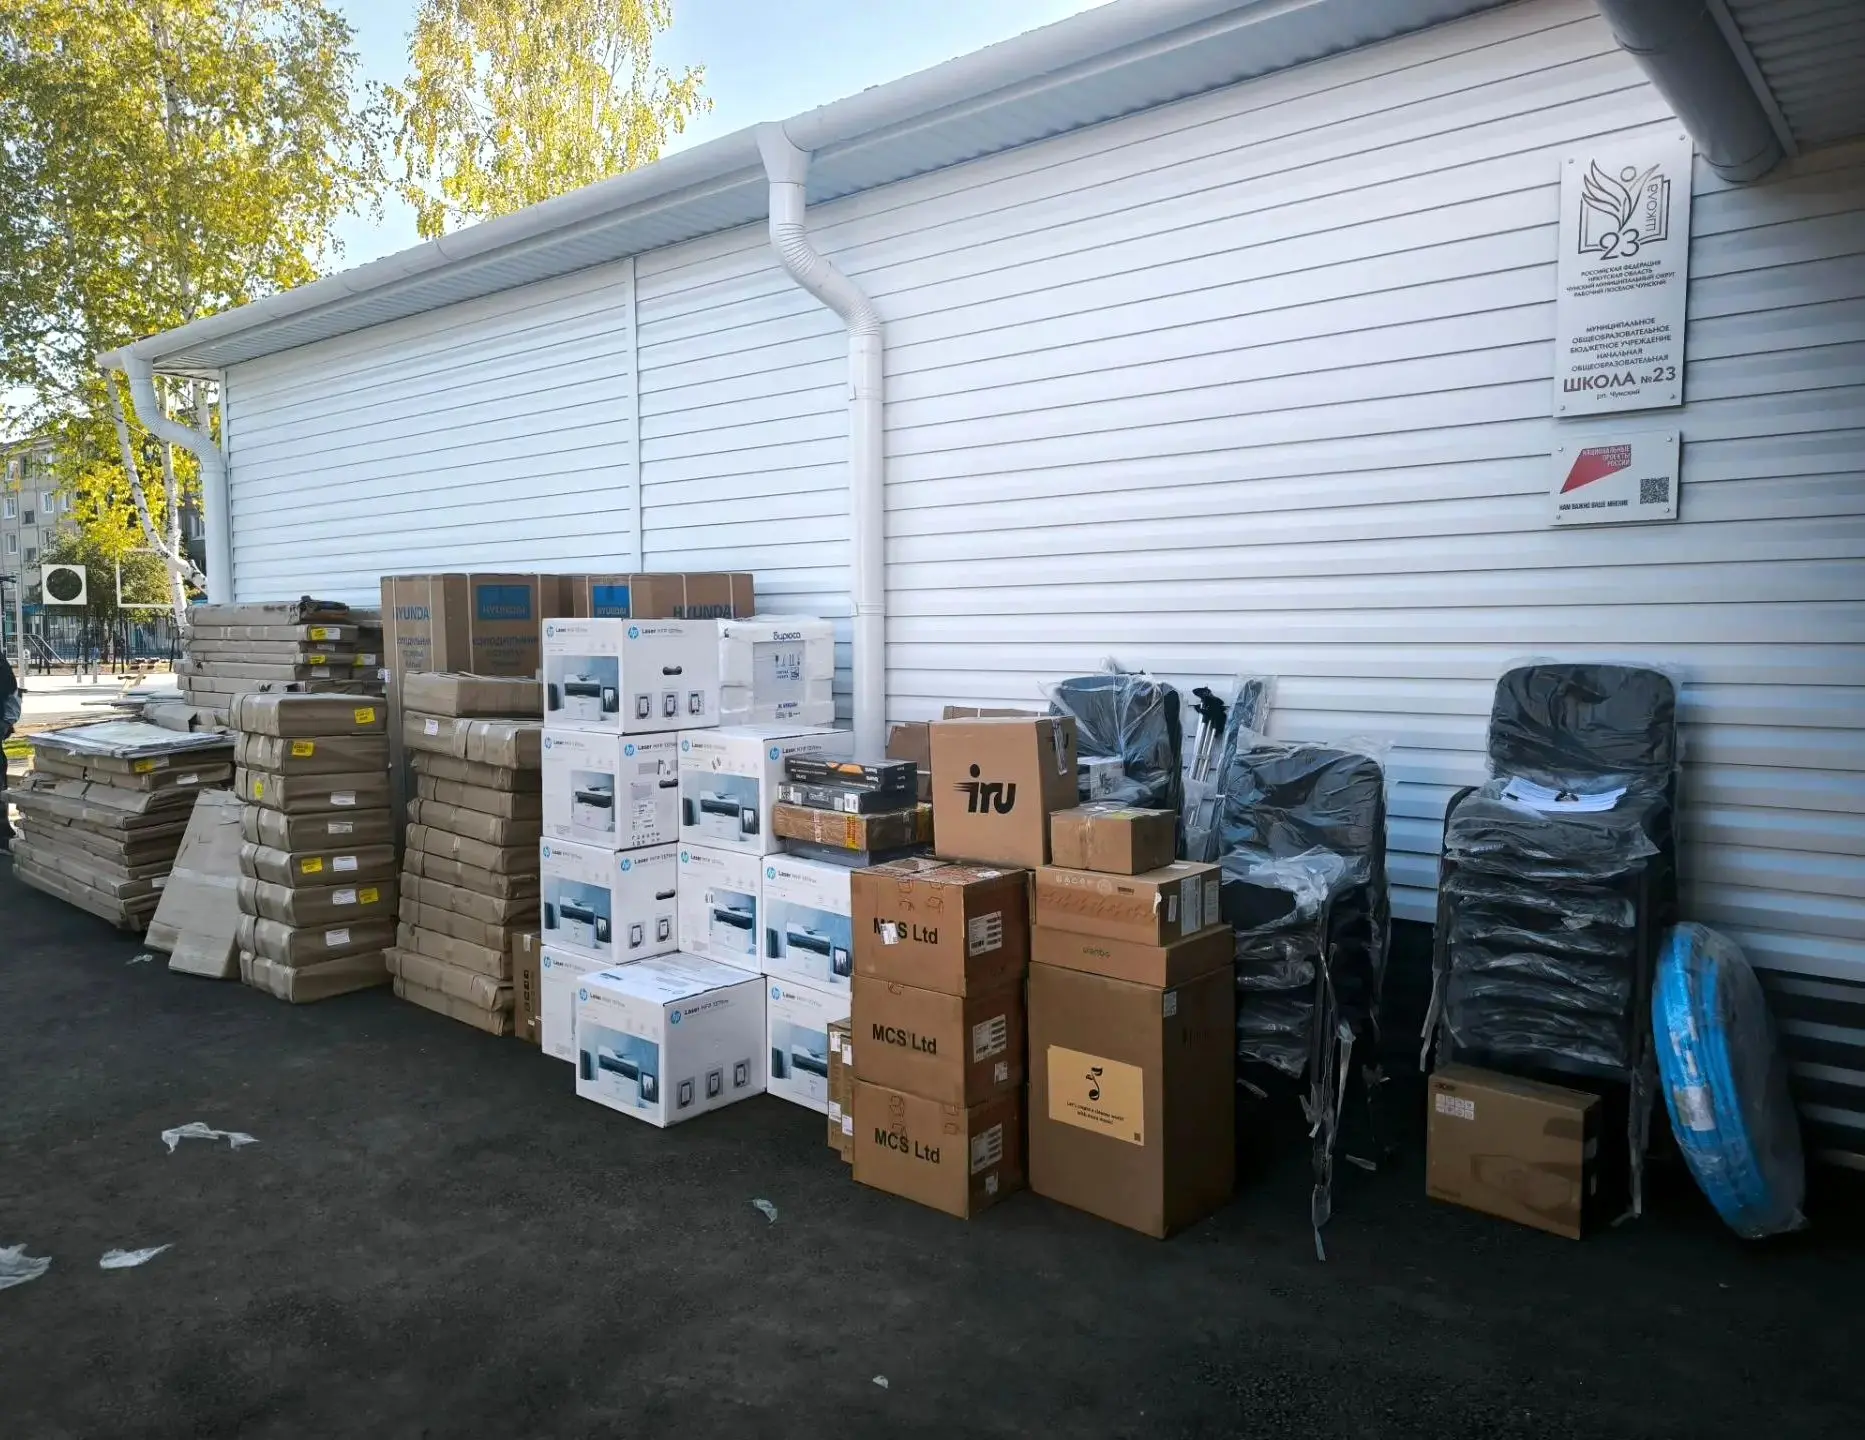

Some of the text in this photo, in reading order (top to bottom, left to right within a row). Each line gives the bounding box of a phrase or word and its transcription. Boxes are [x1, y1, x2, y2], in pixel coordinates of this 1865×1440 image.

[1599, 228, 1640, 260] 23
[1636, 279, 1667, 289] ЧУНСКИЙ
[1572, 325, 1671, 344] ОБЩЕОБРАЗОВАТЕЛЬНОЕ
[1586, 318, 1656, 333] МУНИЦИПАЛЬНОЕ
[1570, 334, 1672, 353] БЮДЖЕТНОЕ УЧРЕЖДЕНИЕ
[1571, 354, 1669, 372] ОБЩЕОБРАЗОВАТЕЛЬНАЯ
[1597, 348, 1643, 359] НАЧАЛЬНАЯ
[1563, 371, 1636, 393] ШКОЛА
[873, 917, 938, 945] MS Ltd
[872, 1023, 937, 1056] MCS Ltd
[874, 1127, 940, 1164] MCS Ltd
